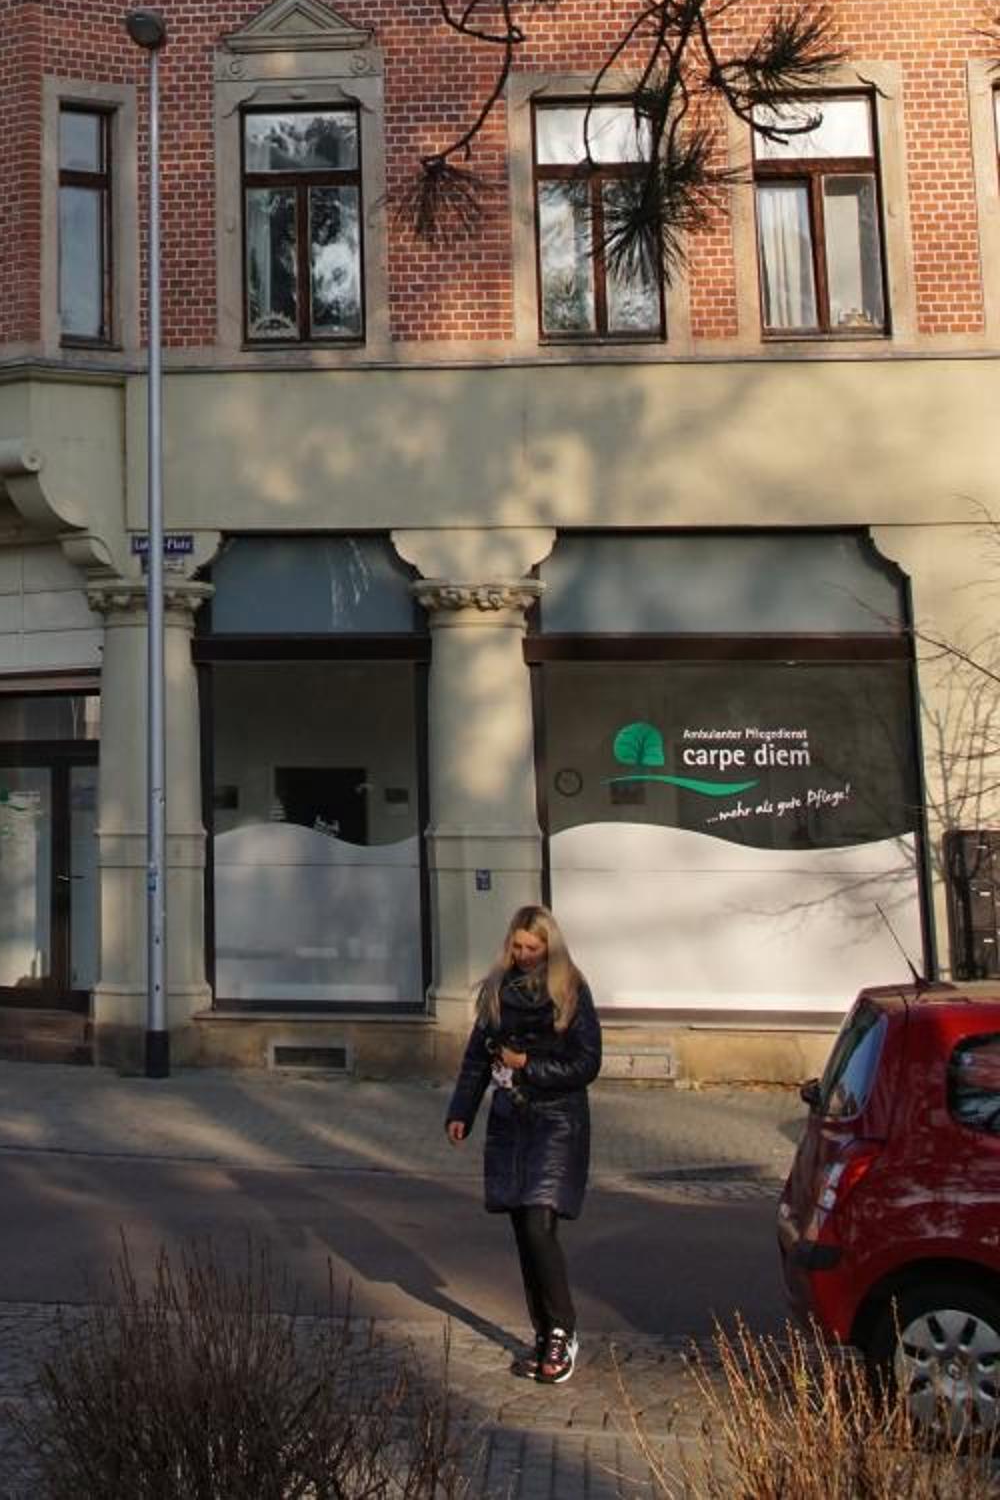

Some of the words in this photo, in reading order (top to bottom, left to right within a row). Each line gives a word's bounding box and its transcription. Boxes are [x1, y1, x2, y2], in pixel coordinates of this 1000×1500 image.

[683, 728, 742, 740] Ambulanter
[745, 727, 808, 742] Pflegedienst
[683, 749, 746, 771] carpe
[754, 743, 811, 766] diem
[755, 800, 774, 815] als
[777, 797, 802, 817] gute
[807, 782, 851, 809] Pflege!
